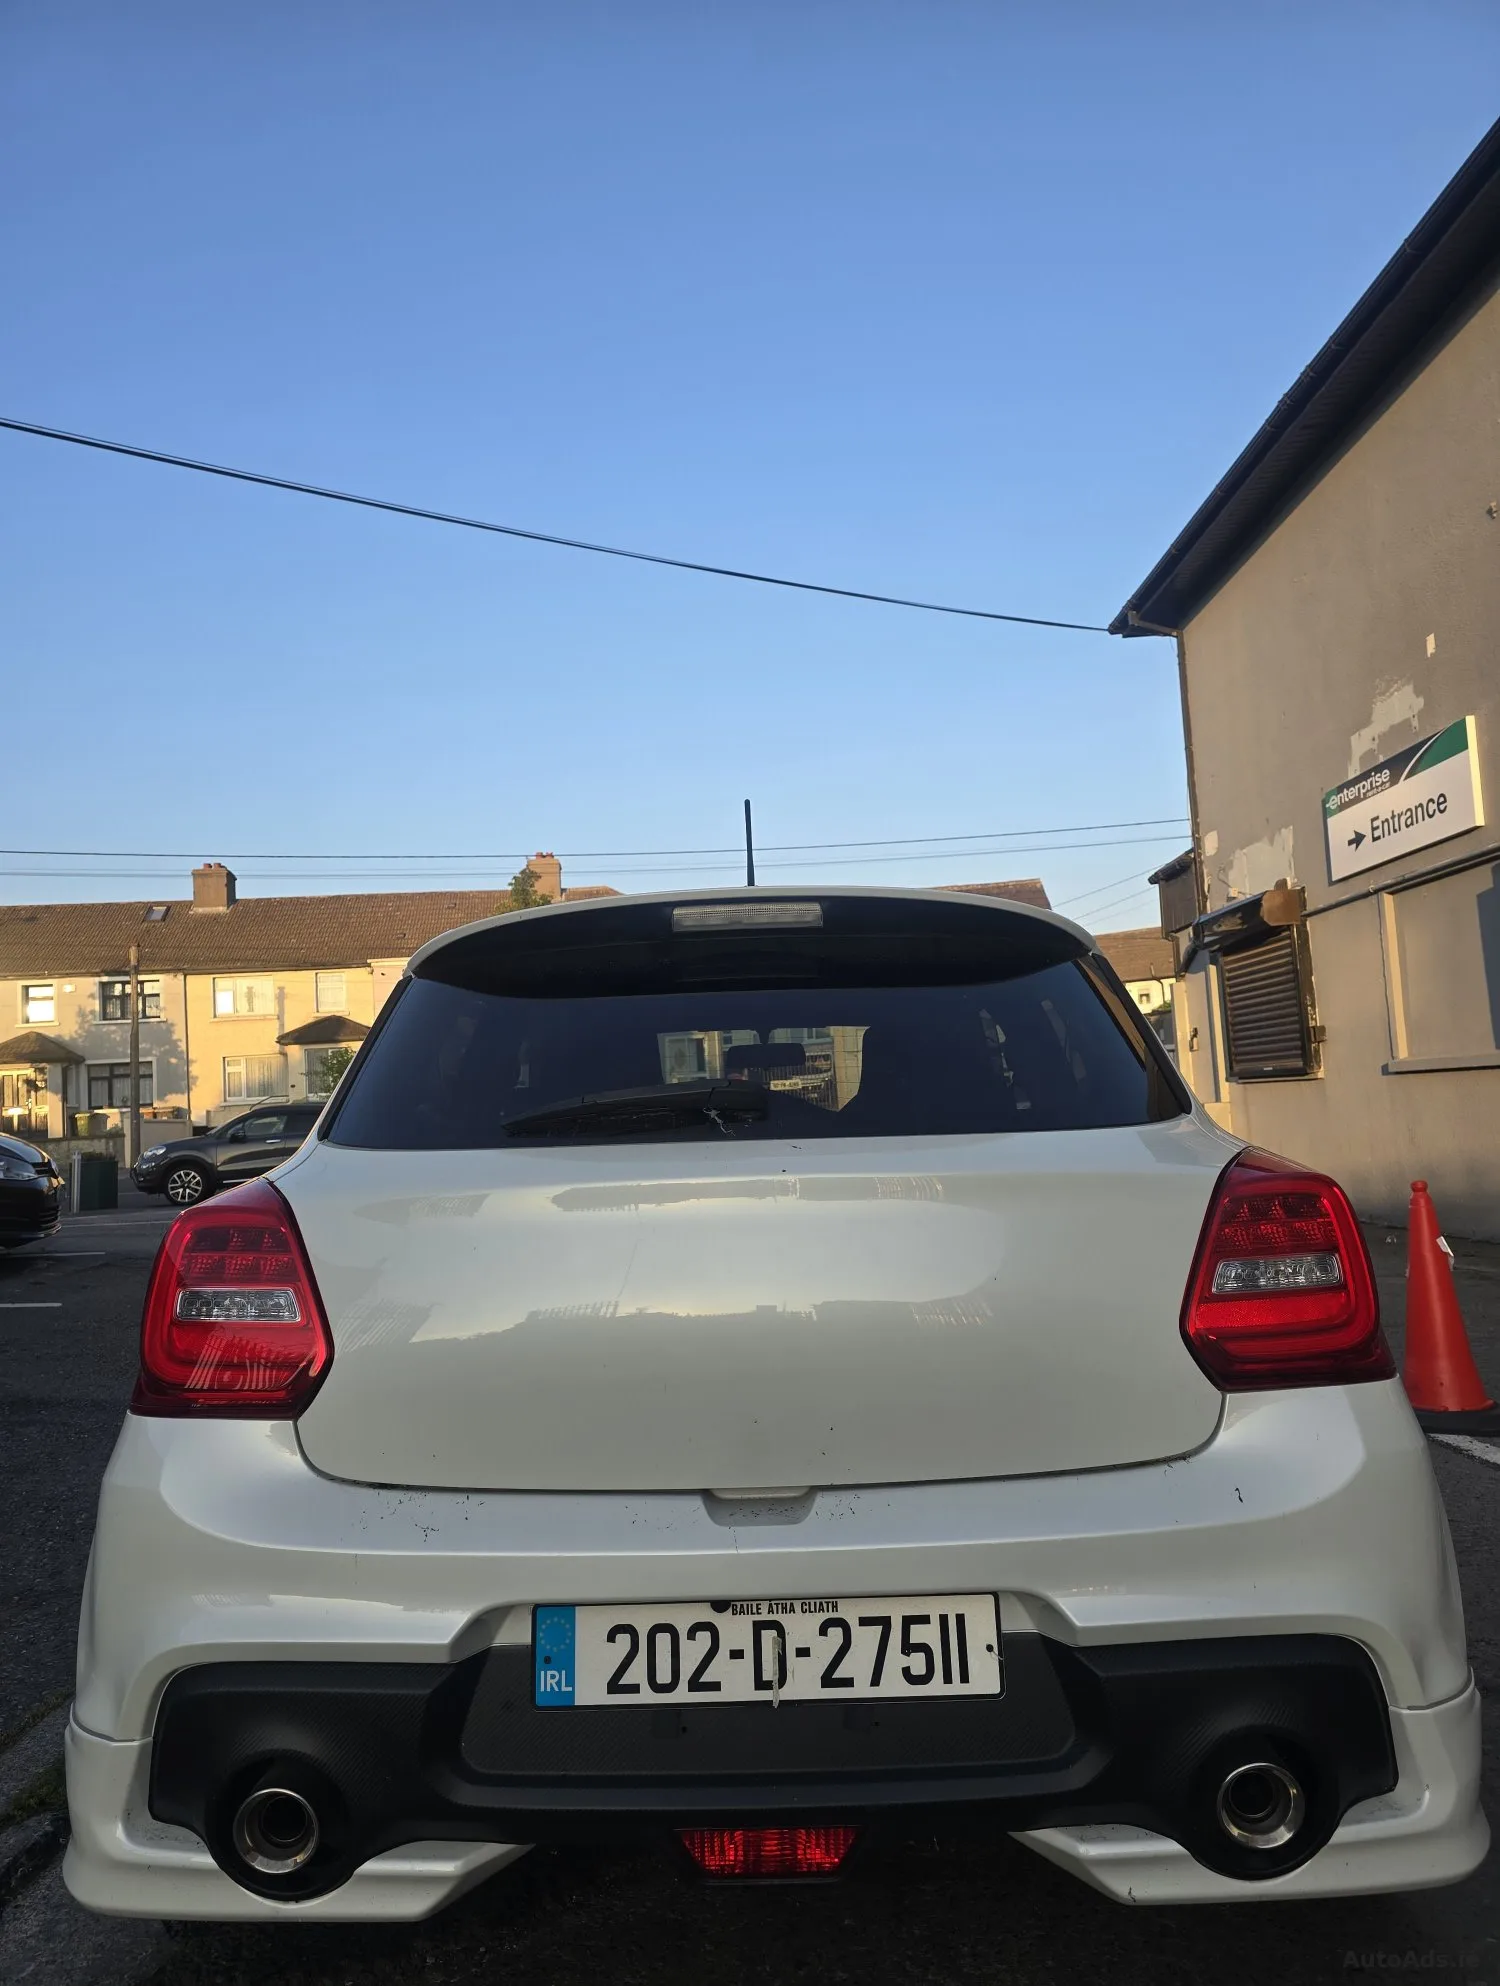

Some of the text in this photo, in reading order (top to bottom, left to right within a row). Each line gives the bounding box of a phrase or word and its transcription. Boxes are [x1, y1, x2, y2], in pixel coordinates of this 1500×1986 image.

[1326, 768, 1391, 810] enterprise
[1370, 792, 1448, 843] Entrance
[731, 1600, 839, 1616] BAILE ÁTHA CLIATH
[605, 1613, 970, 1695] 202-D-27511
[540, 1669, 573, 1692] IRL
